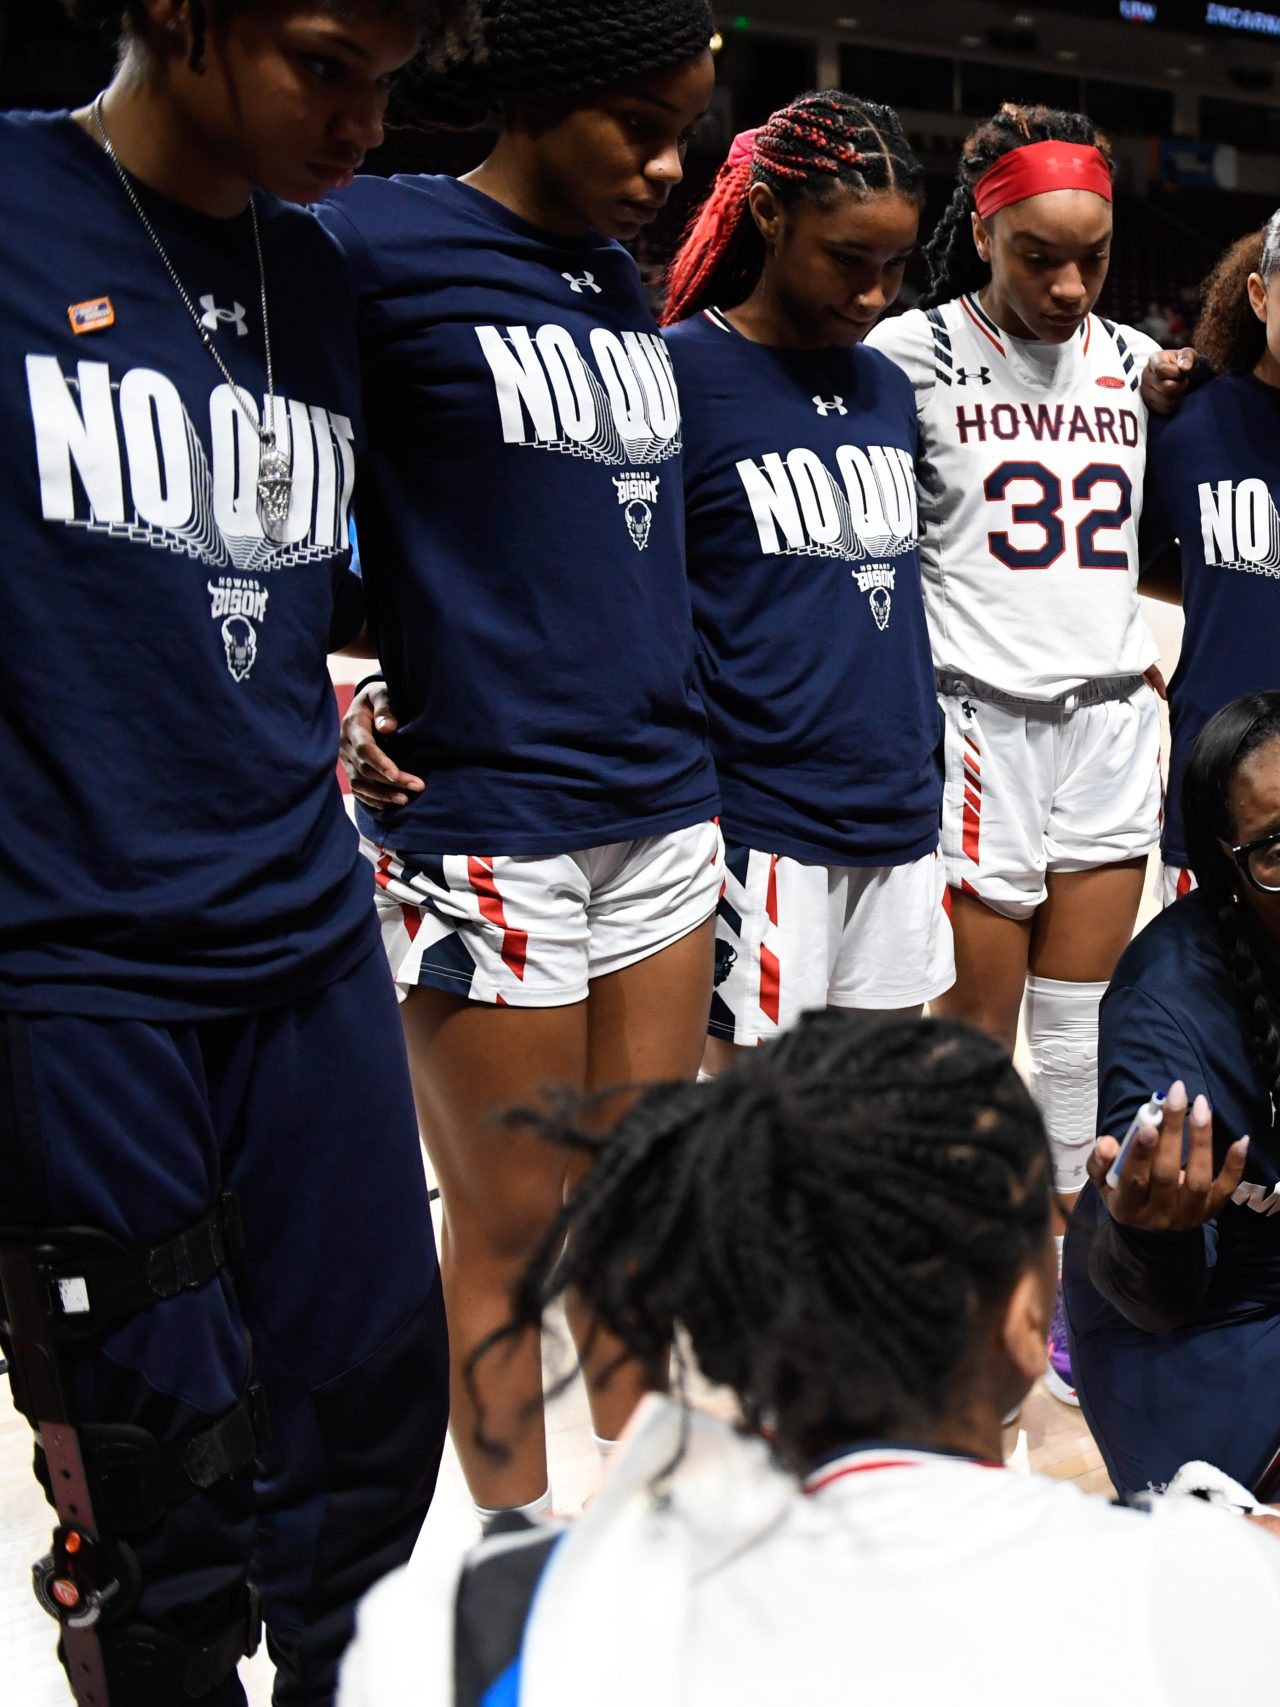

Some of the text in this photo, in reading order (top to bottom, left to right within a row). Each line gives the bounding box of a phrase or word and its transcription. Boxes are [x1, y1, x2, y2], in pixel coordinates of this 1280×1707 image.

[475, 324, 596, 443] NO
[25, 354, 196, 528] NO
[956, 403, 1138, 448] HOWARD
[612, 475, 660, 505] BISON
[620, 471, 651, 480] HOWARD
[735, 444, 919, 555] NO QUI
[983, 460, 1133, 571] 32
[1198, 478, 1270, 565] NO
[207, 580, 270, 623] BISON
[218, 576, 261, 590] HOWARD
[851, 566, 896, 593] BISON
